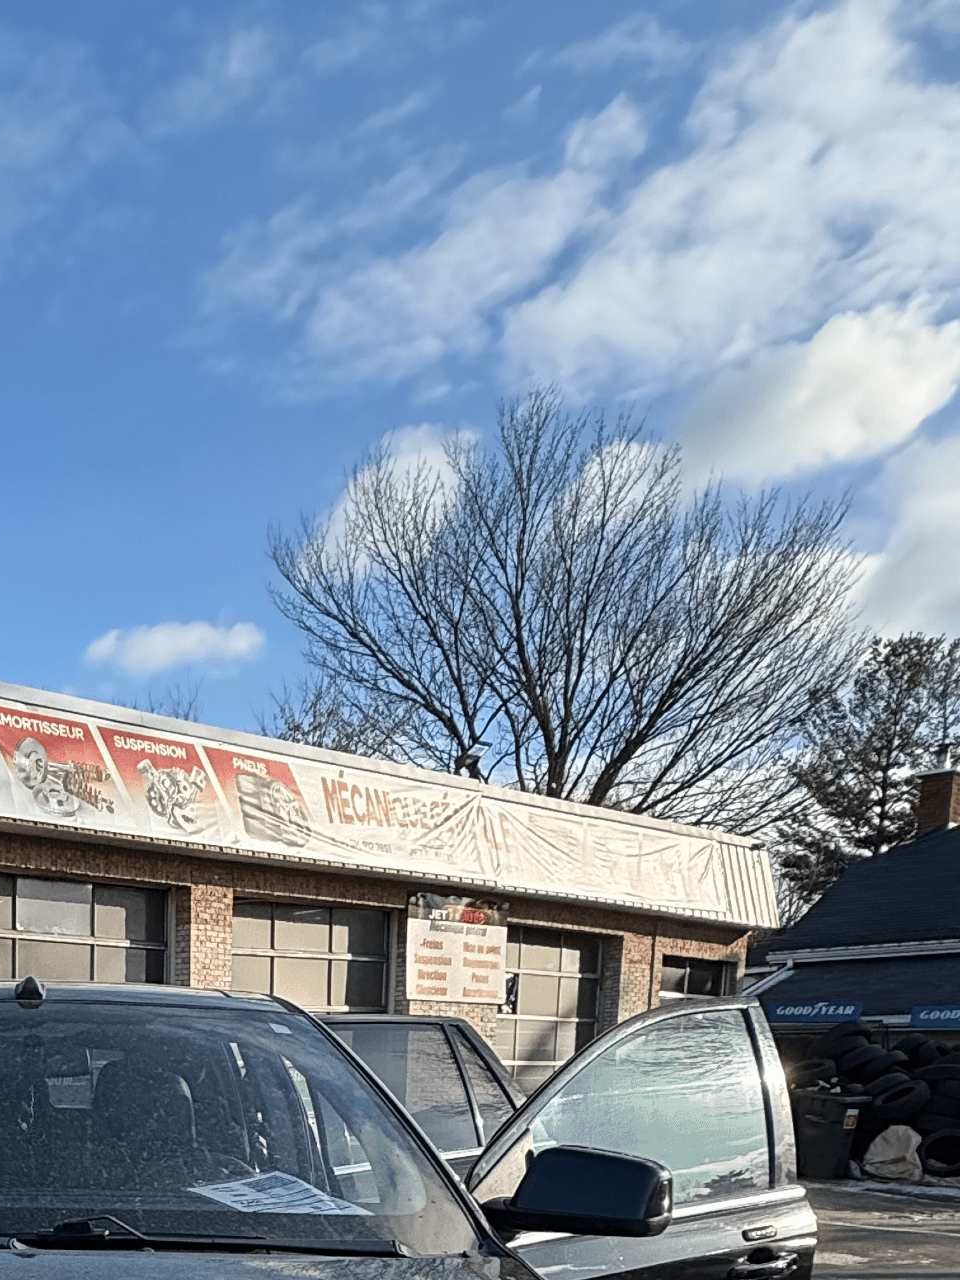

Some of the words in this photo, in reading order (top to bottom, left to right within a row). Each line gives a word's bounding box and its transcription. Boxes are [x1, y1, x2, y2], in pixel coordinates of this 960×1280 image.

[113, 735, 187, 760] SUSPENSION
[232, 756, 268, 776] PNEUS
[428, 908, 449, 920] JET
[776, 1002, 855, 1017] GOODYEAR
